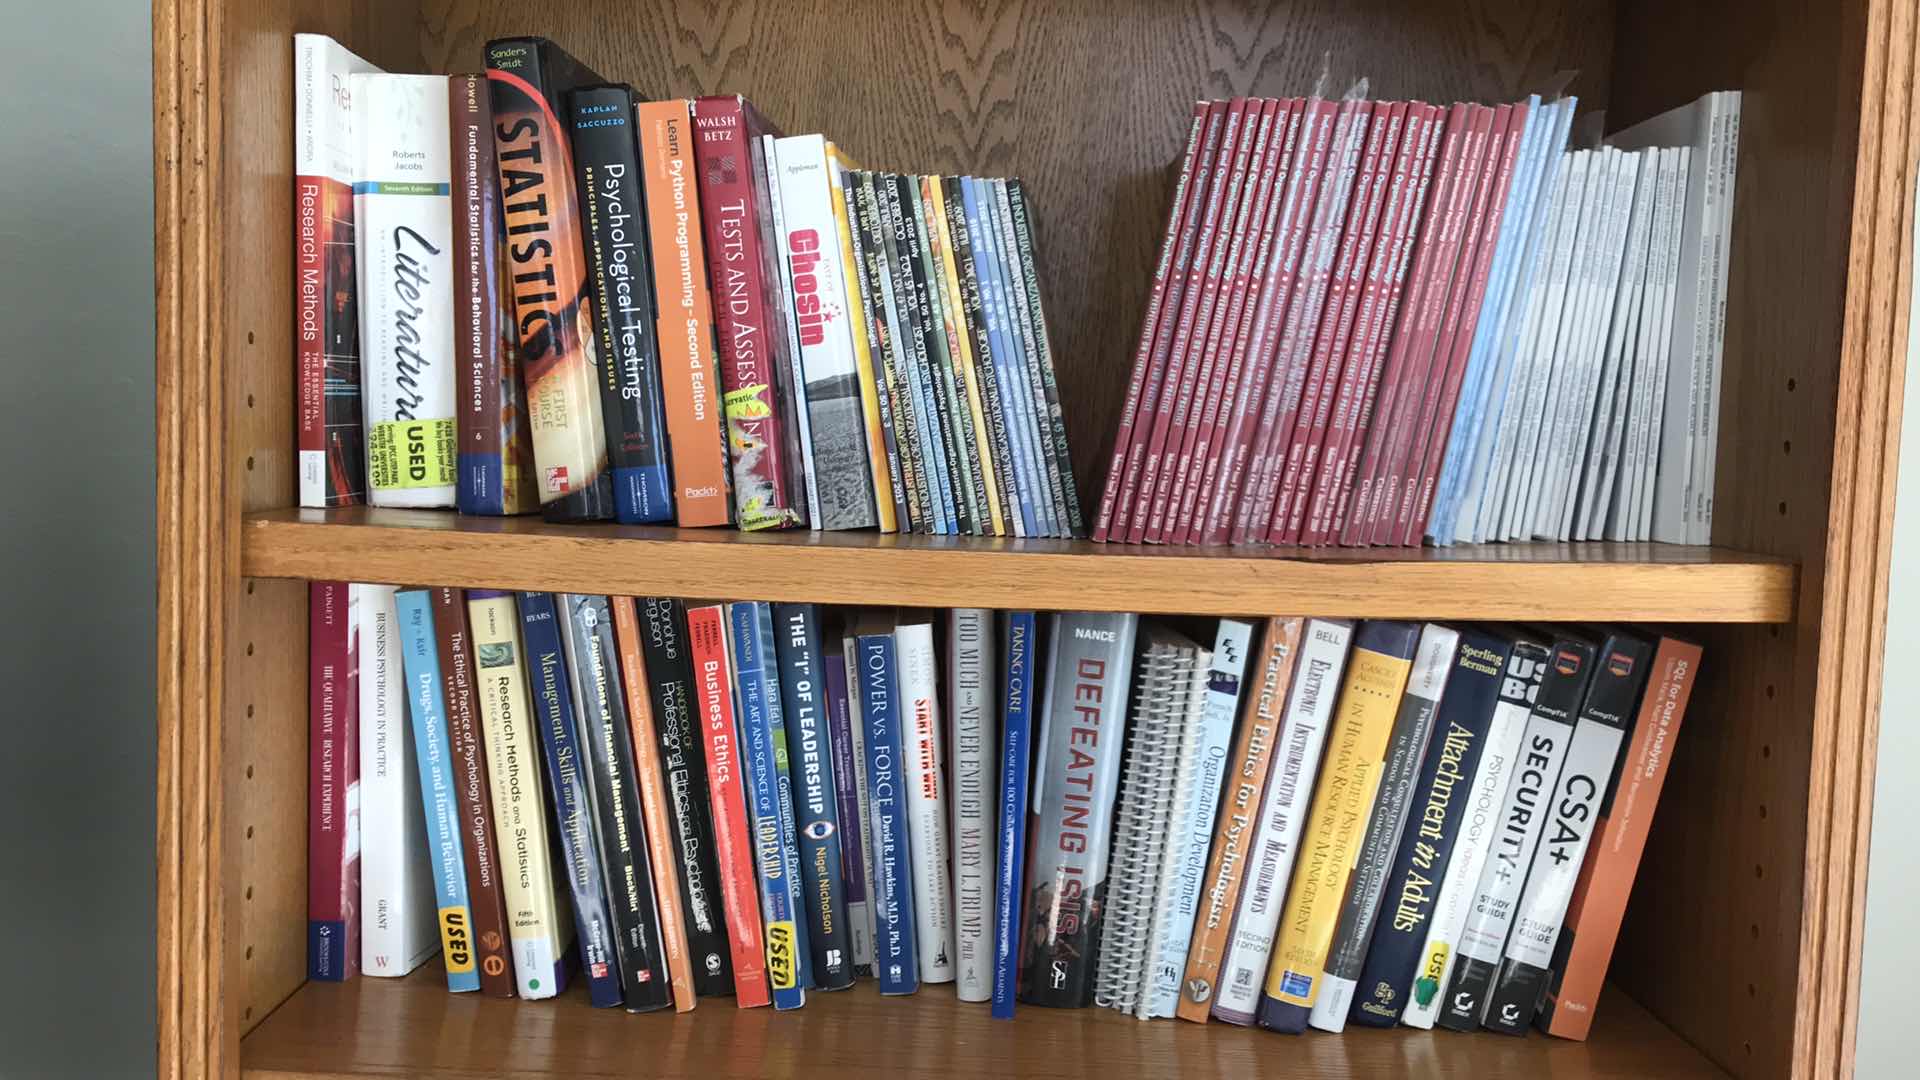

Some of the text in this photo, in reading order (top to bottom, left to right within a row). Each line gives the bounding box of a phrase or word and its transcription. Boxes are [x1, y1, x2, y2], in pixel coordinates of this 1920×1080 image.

[490, 47, 527, 59] Sanders
[497, 59, 522, 69] Smidt
[467, 73, 477, 112] Howell
[581, 104, 618, 114] KAPLAN
[577, 118, 625, 129] SACCUZZO
[697, 116, 736, 128] WALSH
[704, 131, 732, 142] BETZ
[393, 150, 426, 159] Roberts
[394, 162, 423, 171] Jacobs
[843, 187, 853, 202] The
[300, 184, 319, 340] Research Methods
[496, 118, 563, 361] STATISTICS
[598, 163, 639, 313] Psychological
[718, 199, 751, 314] TESTS AND
[846, 204, 869, 295] Industrial-Organizational
[466, 125, 484, 411] Fundamental Statistics for the Behavioral Sciences
[665, 118, 707, 420] Learn Python Programming Second Edition
[788, 229, 825, 346] Chosin
[861, 297, 878, 347] Psychologist
[614, 319, 648, 399] Testing
[876, 378, 886, 395] Vol.
[879, 396, 888, 406] 50
[880, 407, 889, 419] No.
[406, 426, 426, 481] USED
[887, 451, 899, 481] January
[892, 482, 903, 503] 2013
[526, 612, 550, 624] BYARS
[789, 614, 805, 646] THE
[958, 613, 978, 642] TOO
[1074, 628, 1116, 642] NANCE
[1314, 630, 1340, 645] BELL
[868, 645, 885, 712] POWER
[958, 648, 979, 689] MUCH
[1008, 625, 1026, 713] TAKING CARE
[1458, 657, 1497, 676] Berman
[1461, 643, 1503, 667] Sperling
[375, 612, 386, 776] BUSINESS PSYCHOLOGY IN PRACTICE
[796, 680, 812, 702] OF
[1350, 702, 1363, 717] IN
[1536, 704, 1570, 718] CompTIA
[1588, 707, 1622, 723] CompTIA
[1641, 659, 1688, 779] SQL for Data Analytics
[703, 659, 733, 783] Business Ethics
[959, 706, 980, 754] NEVER
[1335, 719, 1361, 773] HUMAN
[416, 673, 458, 898] Drugs, Society, and Human Behavior
[451, 632, 491, 887] The Ethical Practice of Psychology in Organizations
[497, 676, 531, 888] Research Methods and Statistics
[539, 651, 591, 886] Management: Skills and Application
[589, 634, 638, 912] Foundations of Financial Management Block/Hirt
[747, 679, 781, 879] THE ART AND SCIENCE OF LEADERSHIP
[799, 707, 823, 814] LEADERSHIP
[875, 745, 893, 806] FORCE
[1207, 641, 1287, 930] Practical Ethics for Psychologists
[1249, 658, 1331, 916] ELECTRONIC INSTRUMENTATION AND MEASUREMENTS
[960, 760, 981, 818] ENOUGH
[1050, 658, 1106, 935] DEFEATING ISIS
[1318, 774, 1347, 840] RESOURCE
[1465, 753, 1504, 846] PSYCHOLOGY
[1492, 732, 1554, 885] SECURITY+
[778, 775, 804, 897] Communities of Practice
[1178, 744, 1226, 916] Organization Development
[1325, 756, 1371, 892] APPLIED PSYCHOLOGY
[1390, 720, 1478, 936] Attachment in Adults
[1543, 770, 1598, 869] CSA+
[813, 847, 833, 934] Nigel Nicholson
[881, 815, 899, 957] David R. Hawkins, M.D., Ph.D.
[960, 827, 982, 938] MARY L. TRUMP,
[1294, 840, 1331, 935] MANAGEMENT
[1480, 894, 1510, 910] STUDY
[377, 899, 387, 930] GRANT
[444, 911, 469, 965] USED
[1240, 930, 1270, 944] SECOND
[1476, 904, 1506, 920] GUIDE
[1518, 928, 1552, 945] GUIDE
[1520, 917, 1555, 934] STUDY
[768, 927, 790, 988] USED
[1235, 941, 1268, 953] EDITION
